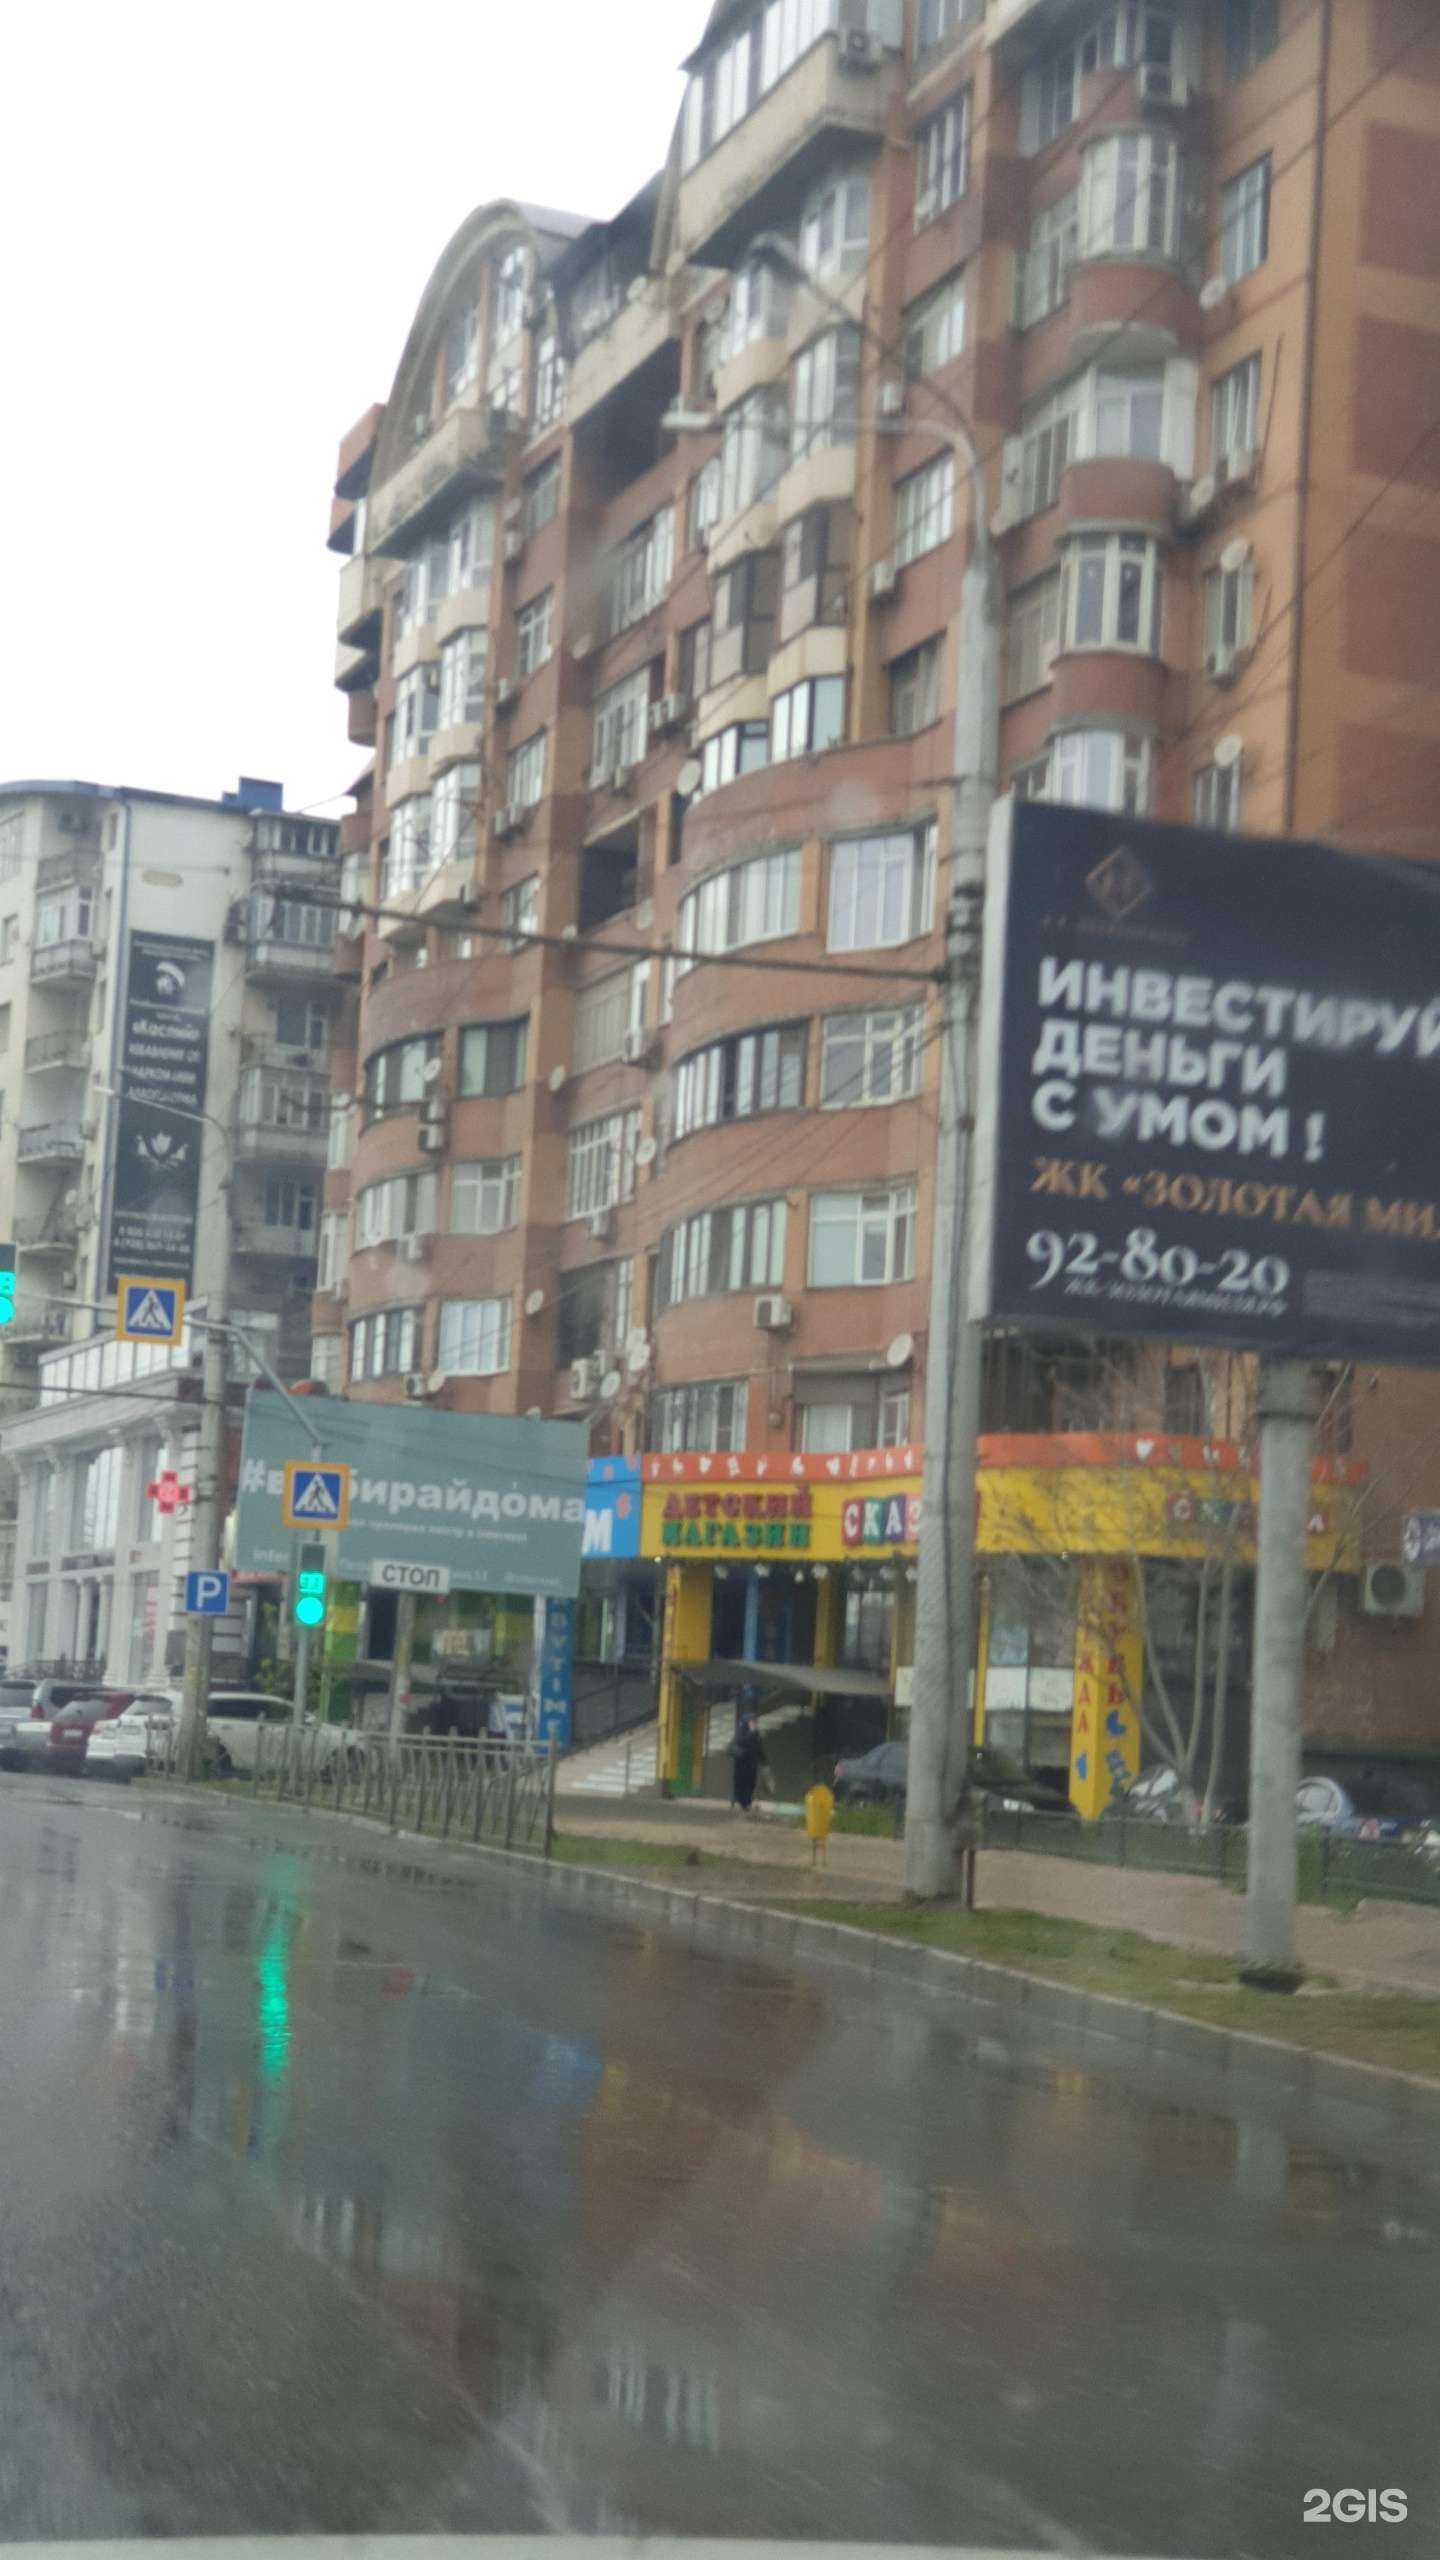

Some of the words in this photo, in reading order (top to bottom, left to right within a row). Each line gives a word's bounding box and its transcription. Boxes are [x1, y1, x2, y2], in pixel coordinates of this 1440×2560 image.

[1031, 1016, 1288, 1099] ДЕНЬГИ
[1031, 1078, 1077, 1132] С
[1092, 1086, 1291, 1159] УМОМ
[1028, 1156, 1108, 1199] ЖК
[1361, 1195, 1440, 1243] МИ
[1025, 1226, 1290, 1295] 92-80-20
[662, 1484, 812, 1519] ДЕТСКИЙ
[844, 1499, 922, 1539] СКАЗ
[661, 1520, 811, 1546] МАГАЗИН
[381, 1563, 441, 1588] СТОП
